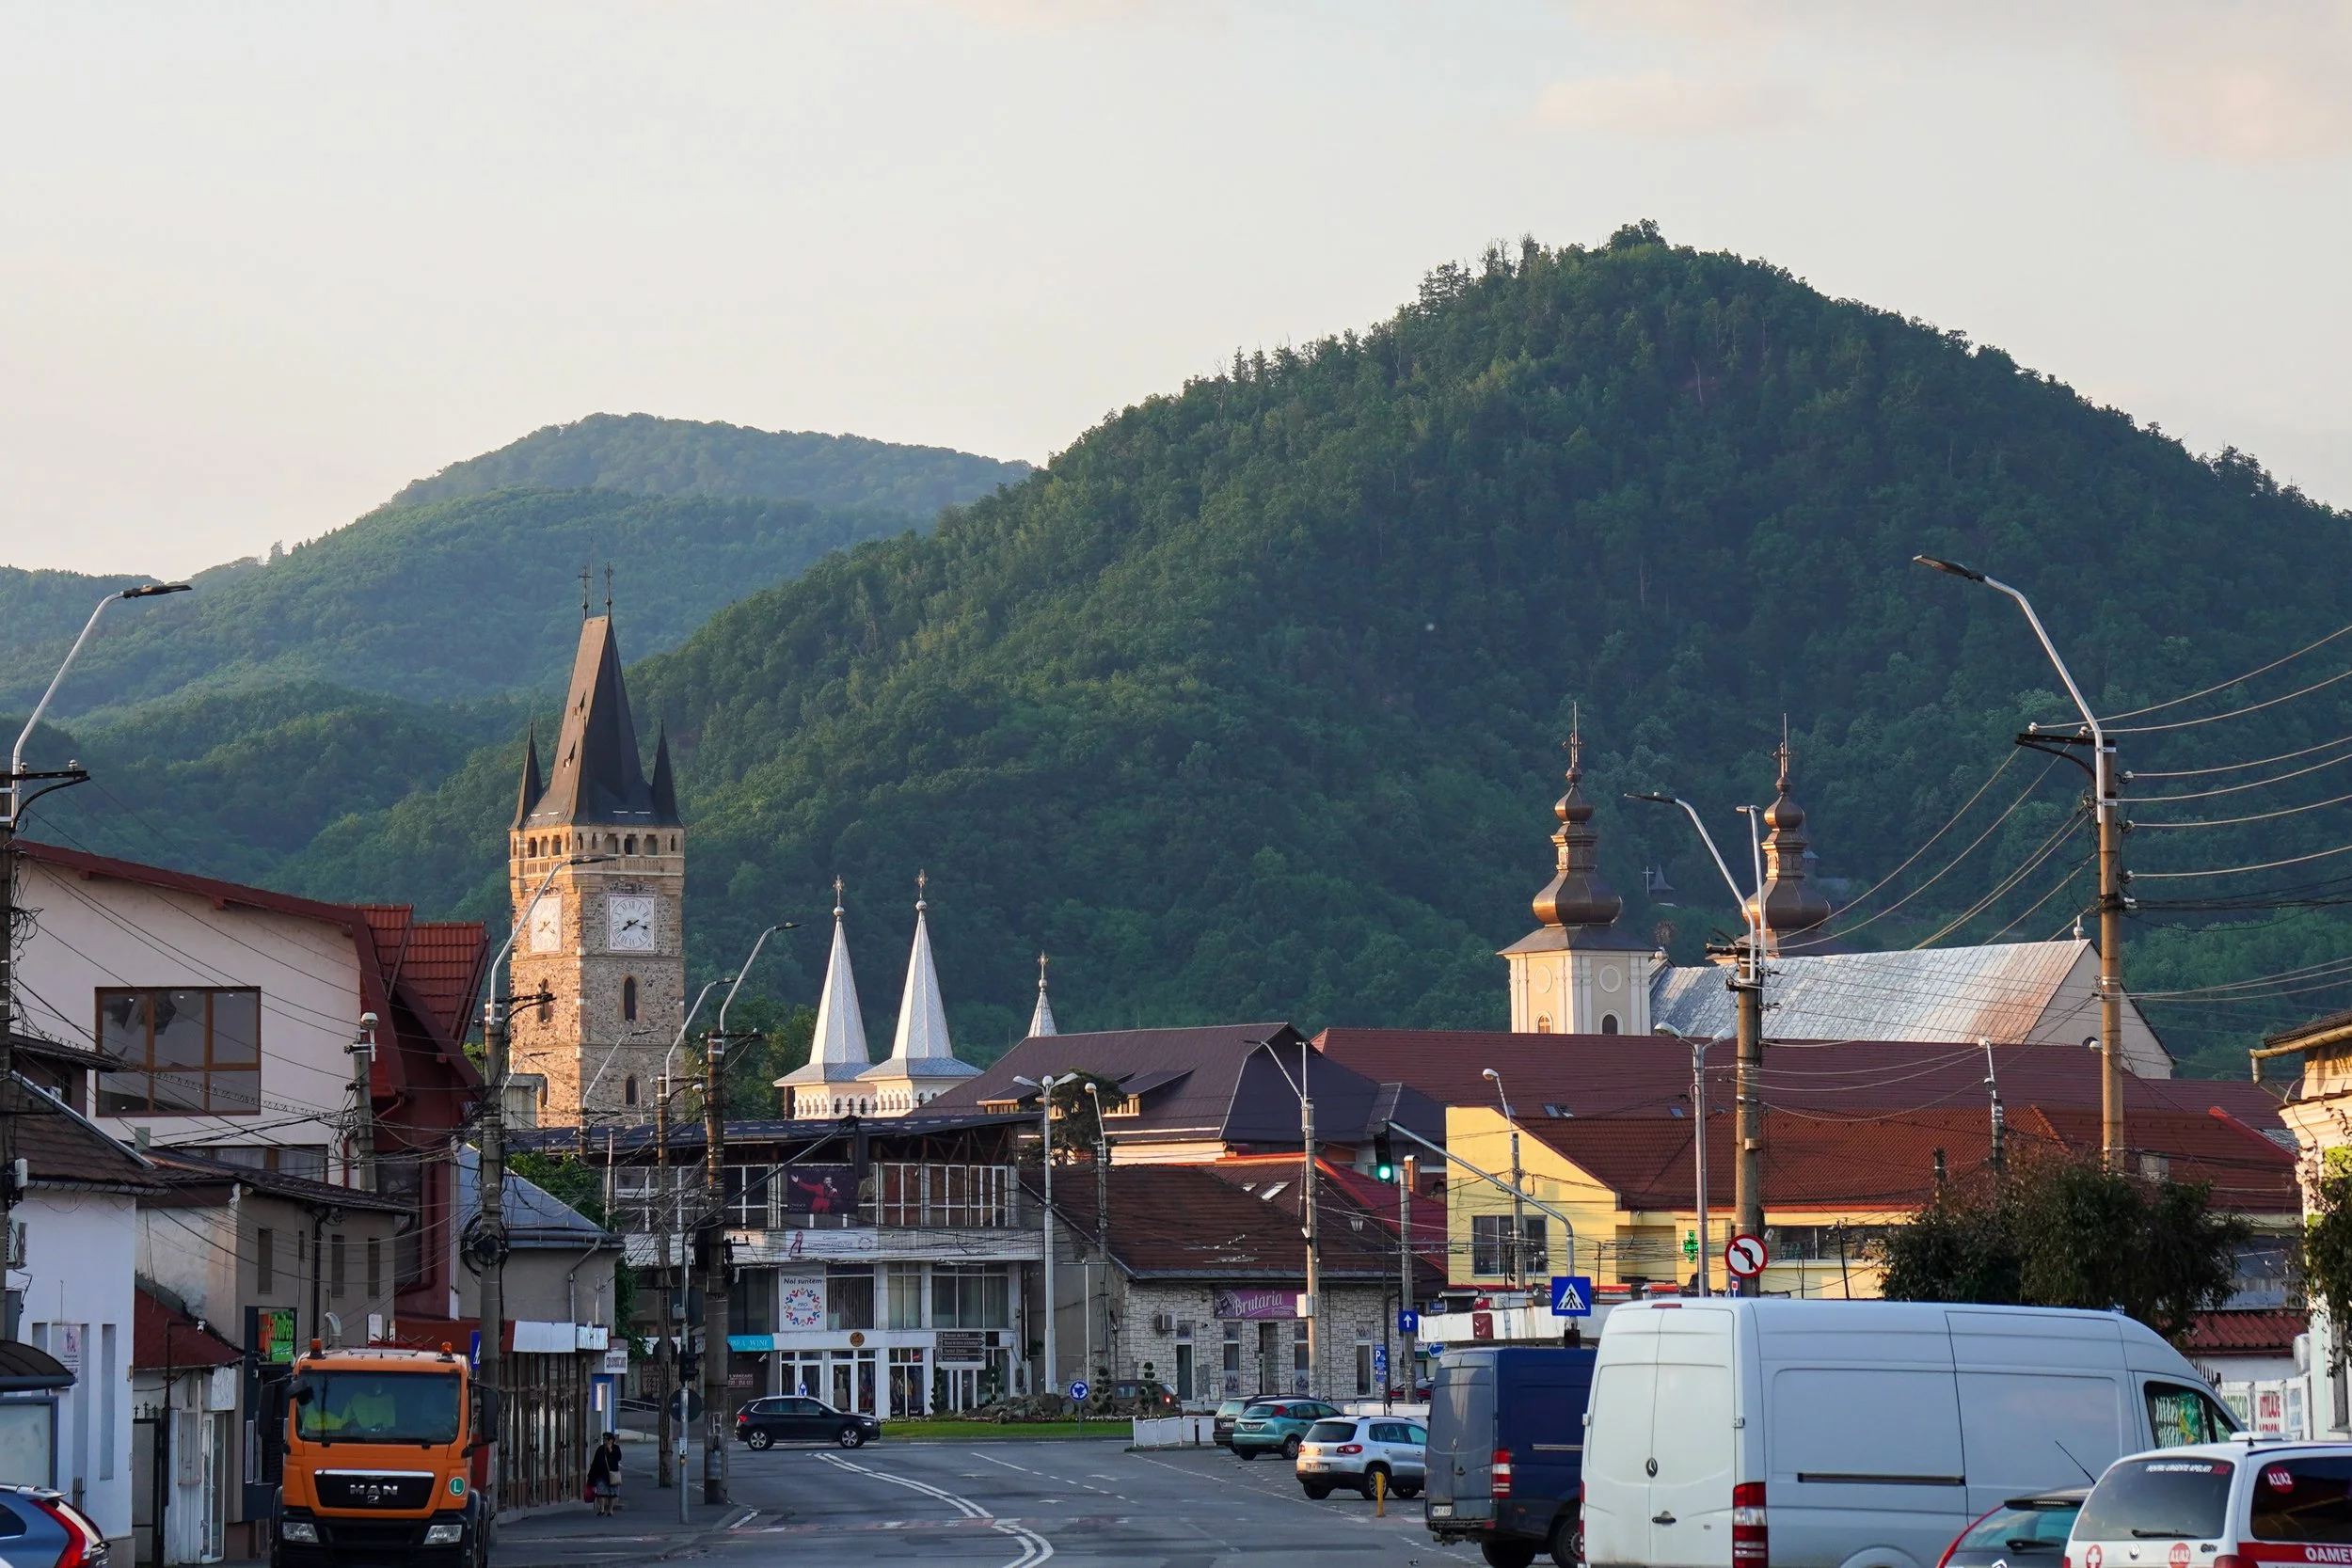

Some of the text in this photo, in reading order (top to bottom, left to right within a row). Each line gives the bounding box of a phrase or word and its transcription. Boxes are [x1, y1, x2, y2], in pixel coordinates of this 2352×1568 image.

[1375, 1350, 1381, 1361] P
[2267, 1470, 2293, 1486] A1/A2
[349, 1483, 399, 1496] MAN
[453, 1480, 461, 1493] L
[2305, 1547, 2352, 1564] OAME
